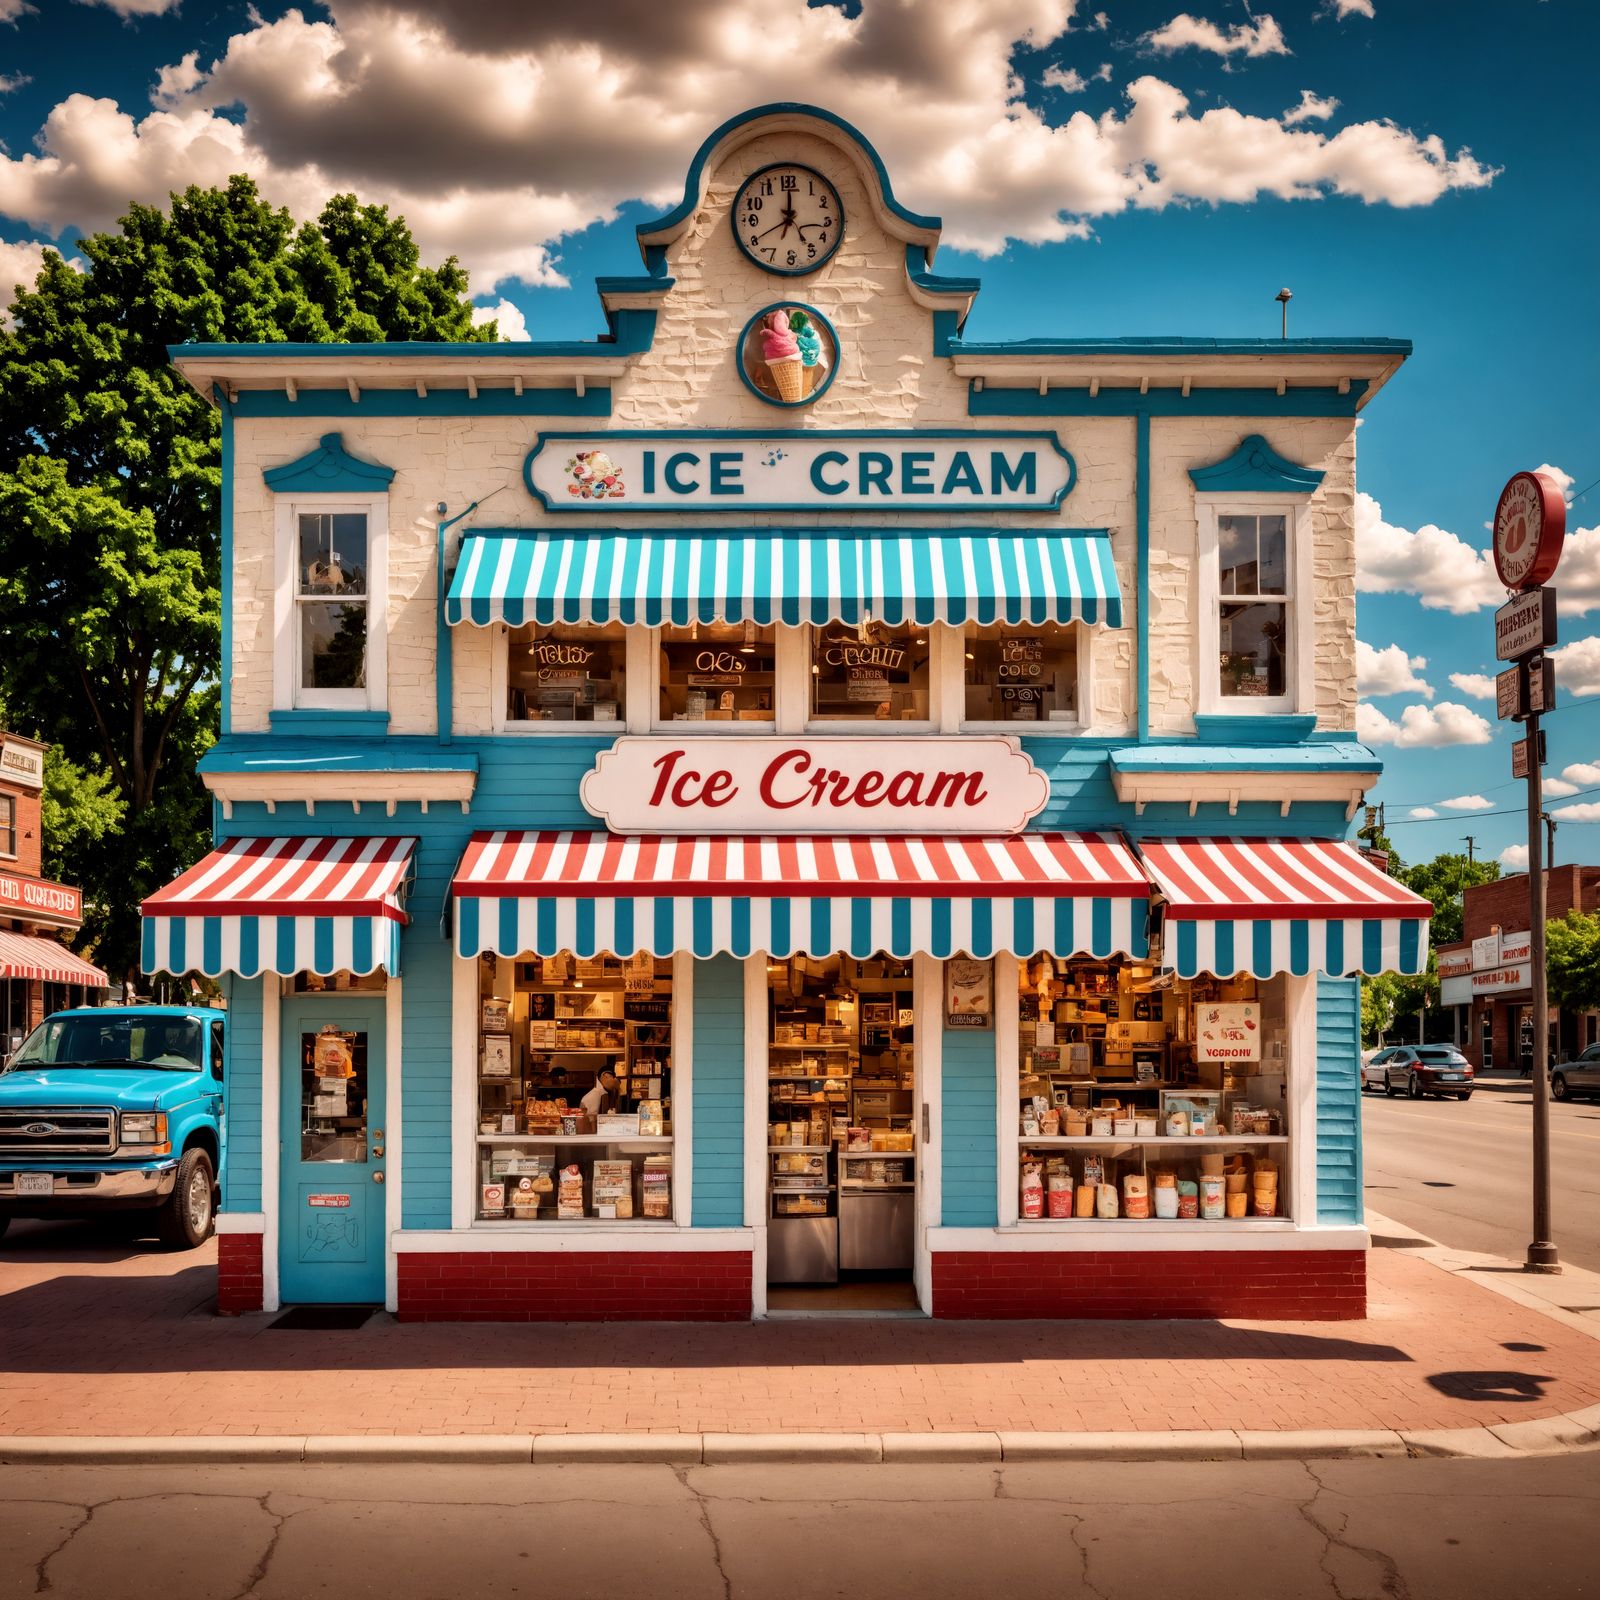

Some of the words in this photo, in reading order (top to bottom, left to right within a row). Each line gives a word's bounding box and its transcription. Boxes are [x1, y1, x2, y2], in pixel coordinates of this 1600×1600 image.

[642, 450, 745, 496] ICE
[809, 450, 1037, 497] CREAM
[649, 750, 738, 808] Ice
